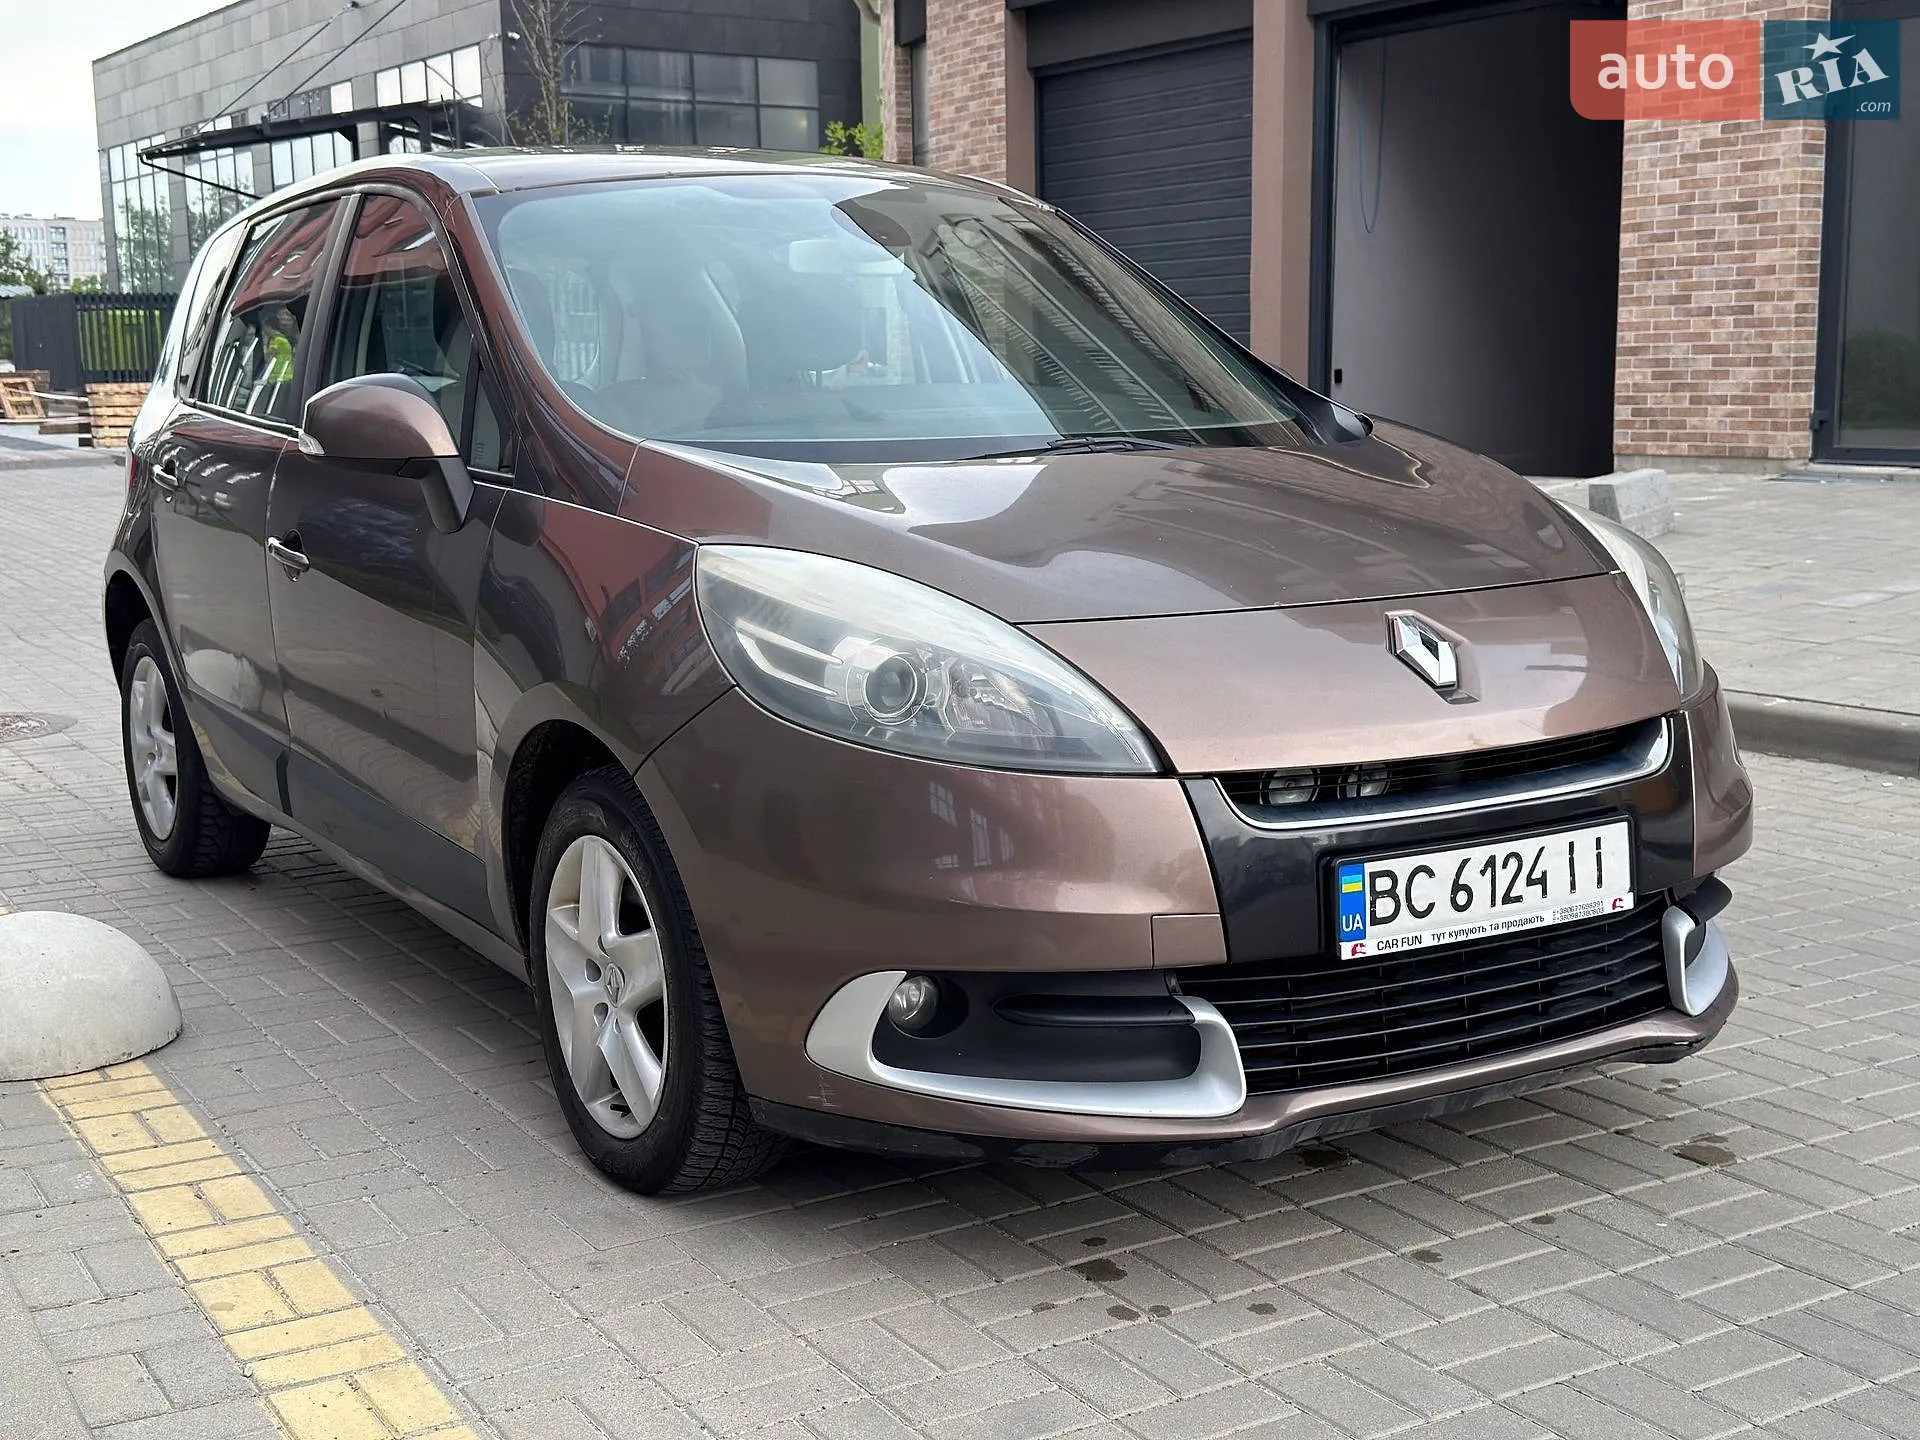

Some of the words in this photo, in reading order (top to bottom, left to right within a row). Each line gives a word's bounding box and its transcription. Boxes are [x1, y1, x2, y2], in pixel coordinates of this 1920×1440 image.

[1369, 864, 1436, 926] BC
[1450, 845, 1548, 913] 6124
[1342, 913, 1363, 931] UA
[1377, 939, 1399, 951] CAR
[1401, 935, 1422, 948] FUN
[1431, 931, 1447, 943] тут
[1448, 926, 1487, 939] купують
[1488, 922, 1500, 932] та
[1501, 914, 1545, 928] продають
